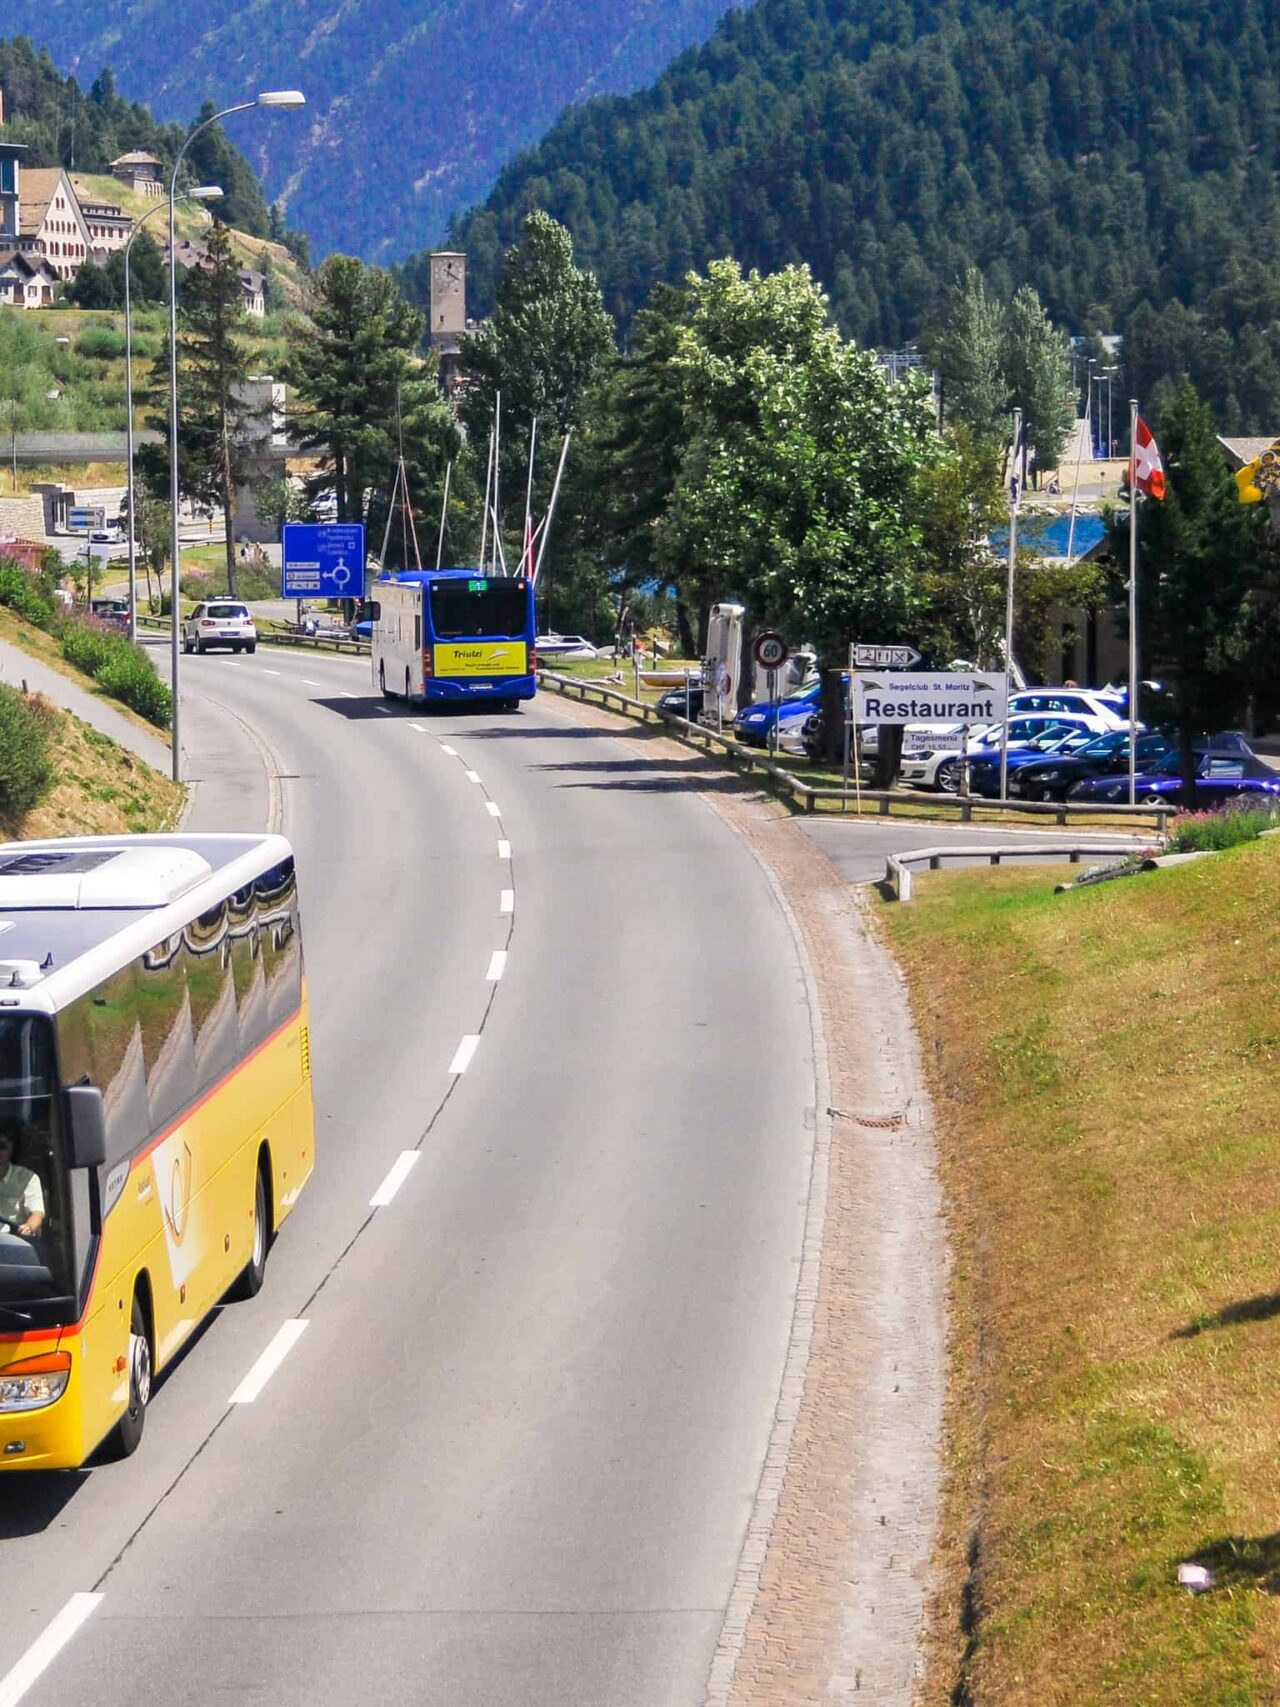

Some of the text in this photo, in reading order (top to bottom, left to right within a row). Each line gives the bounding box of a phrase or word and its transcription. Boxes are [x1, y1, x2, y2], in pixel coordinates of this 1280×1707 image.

[453, 650, 483, 659] Triulzi
[763, 644, 779, 658] 60
[888, 682, 971, 691] Segelclub St. Moritz
[865, 698, 993, 717] Restaurant
